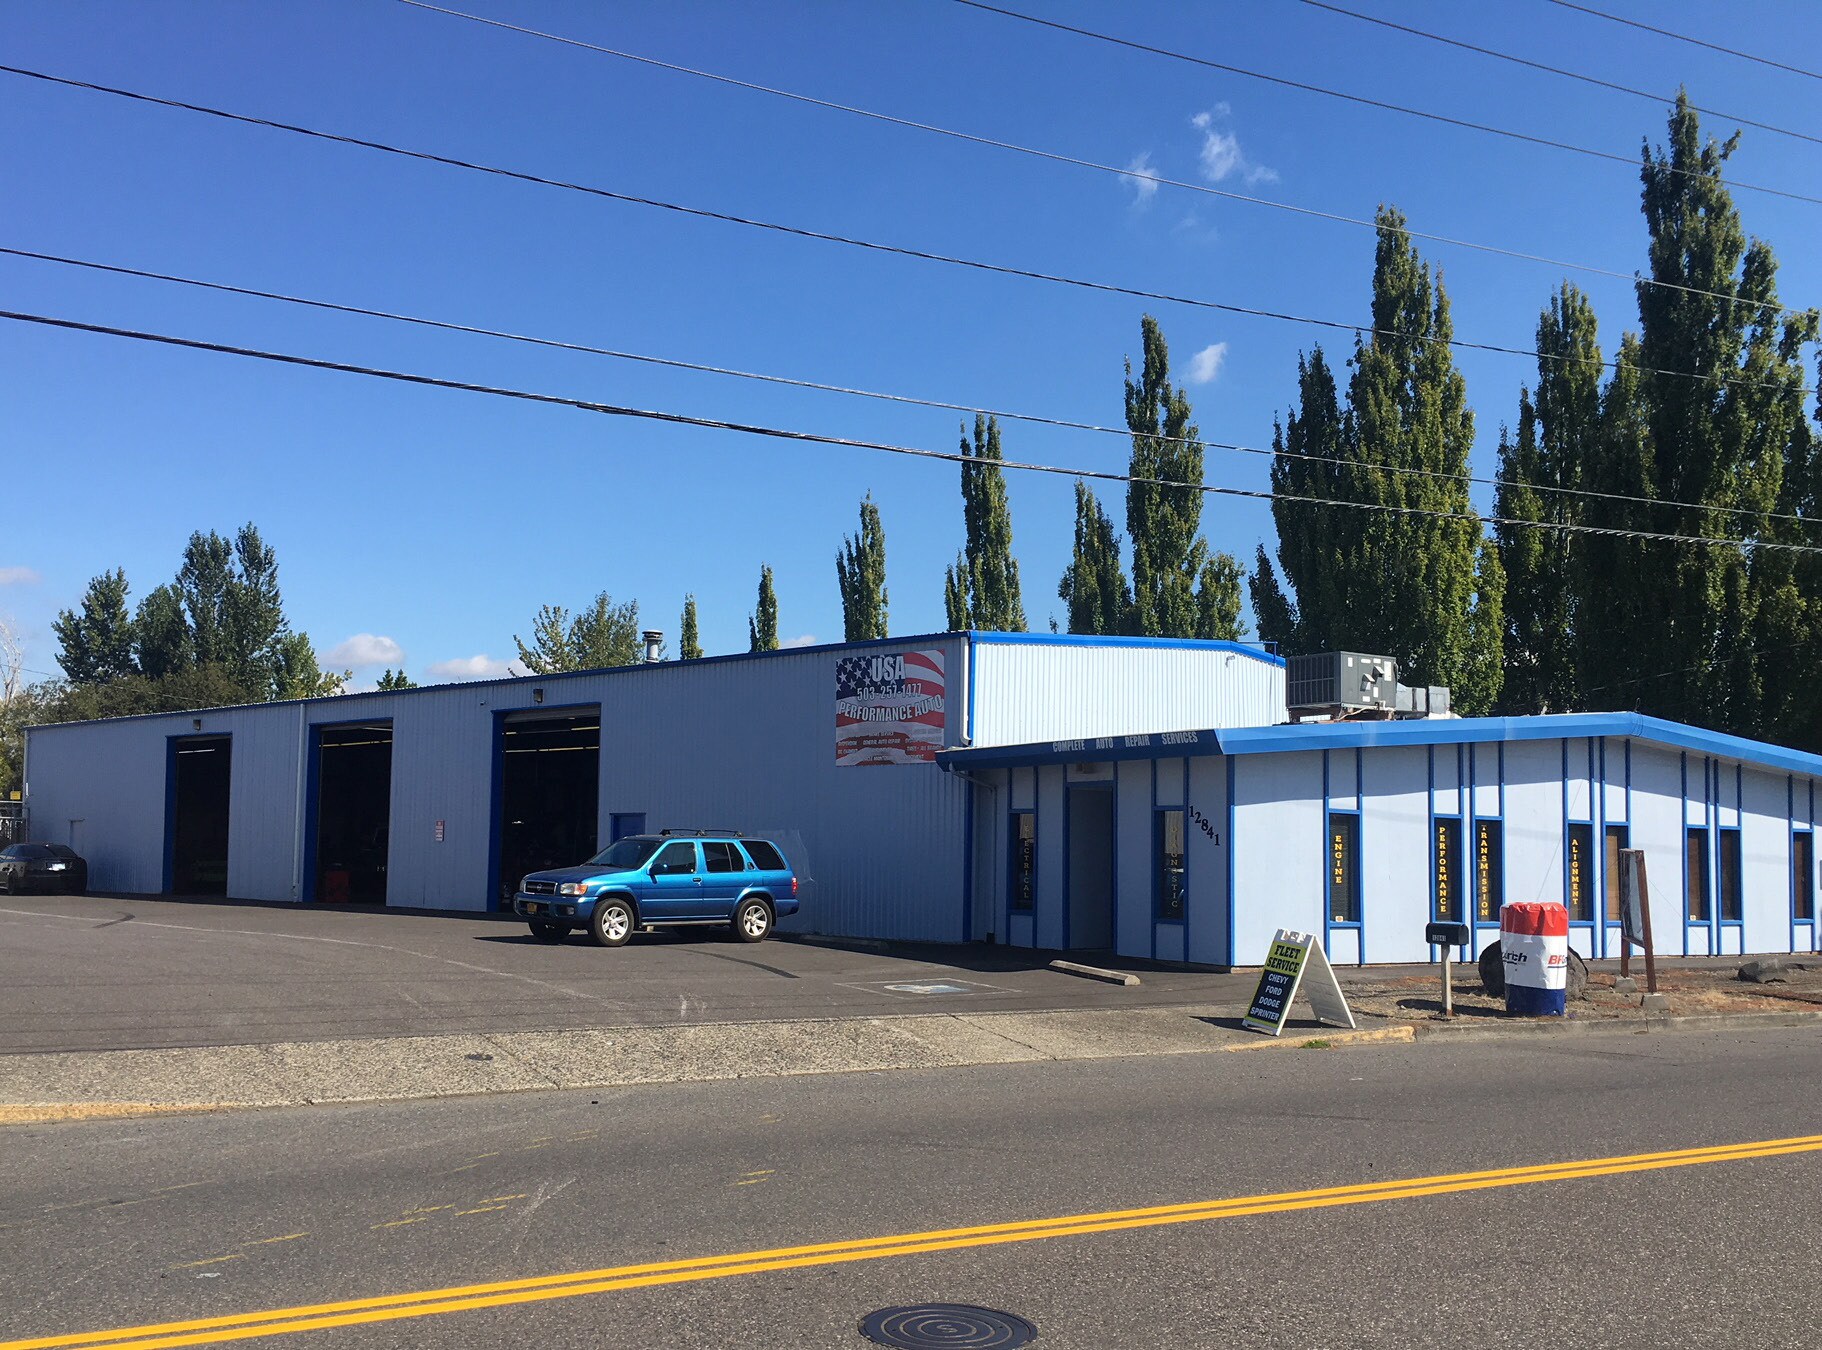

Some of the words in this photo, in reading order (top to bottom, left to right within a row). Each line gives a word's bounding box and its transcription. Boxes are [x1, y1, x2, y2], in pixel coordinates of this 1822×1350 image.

[871, 656, 906, 682] USA
[857, 683, 922, 701] 503-257-1477
[839, 701, 913, 722] PERFORMANCE
[915, 694, 943, 717] AUTO
[1052, 740, 1085, 752] COMPLETE
[1096, 738, 1114, 750] AUTO
[1125, 735, 1150, 748] REPAIR
[1161, 732, 1199, 745] SERVICES
[1189, 805, 1220, 846] 12841
[1334, 835, 1343, 884] ENGINE
[1438, 827, 1447, 912] PERFORMANCE
[1571, 839, 1580, 904] ALIGNMENT
[1274, 945, 1301, 959] FLEET
[1266, 956, 1300, 974] SERVICE
[1268, 973, 1289, 985] CHEVY
[1265, 985, 1282, 996] FORD
[1258, 996, 1280, 1009] DODGE
[1250, 1006, 1280, 1021] SPRINTER
